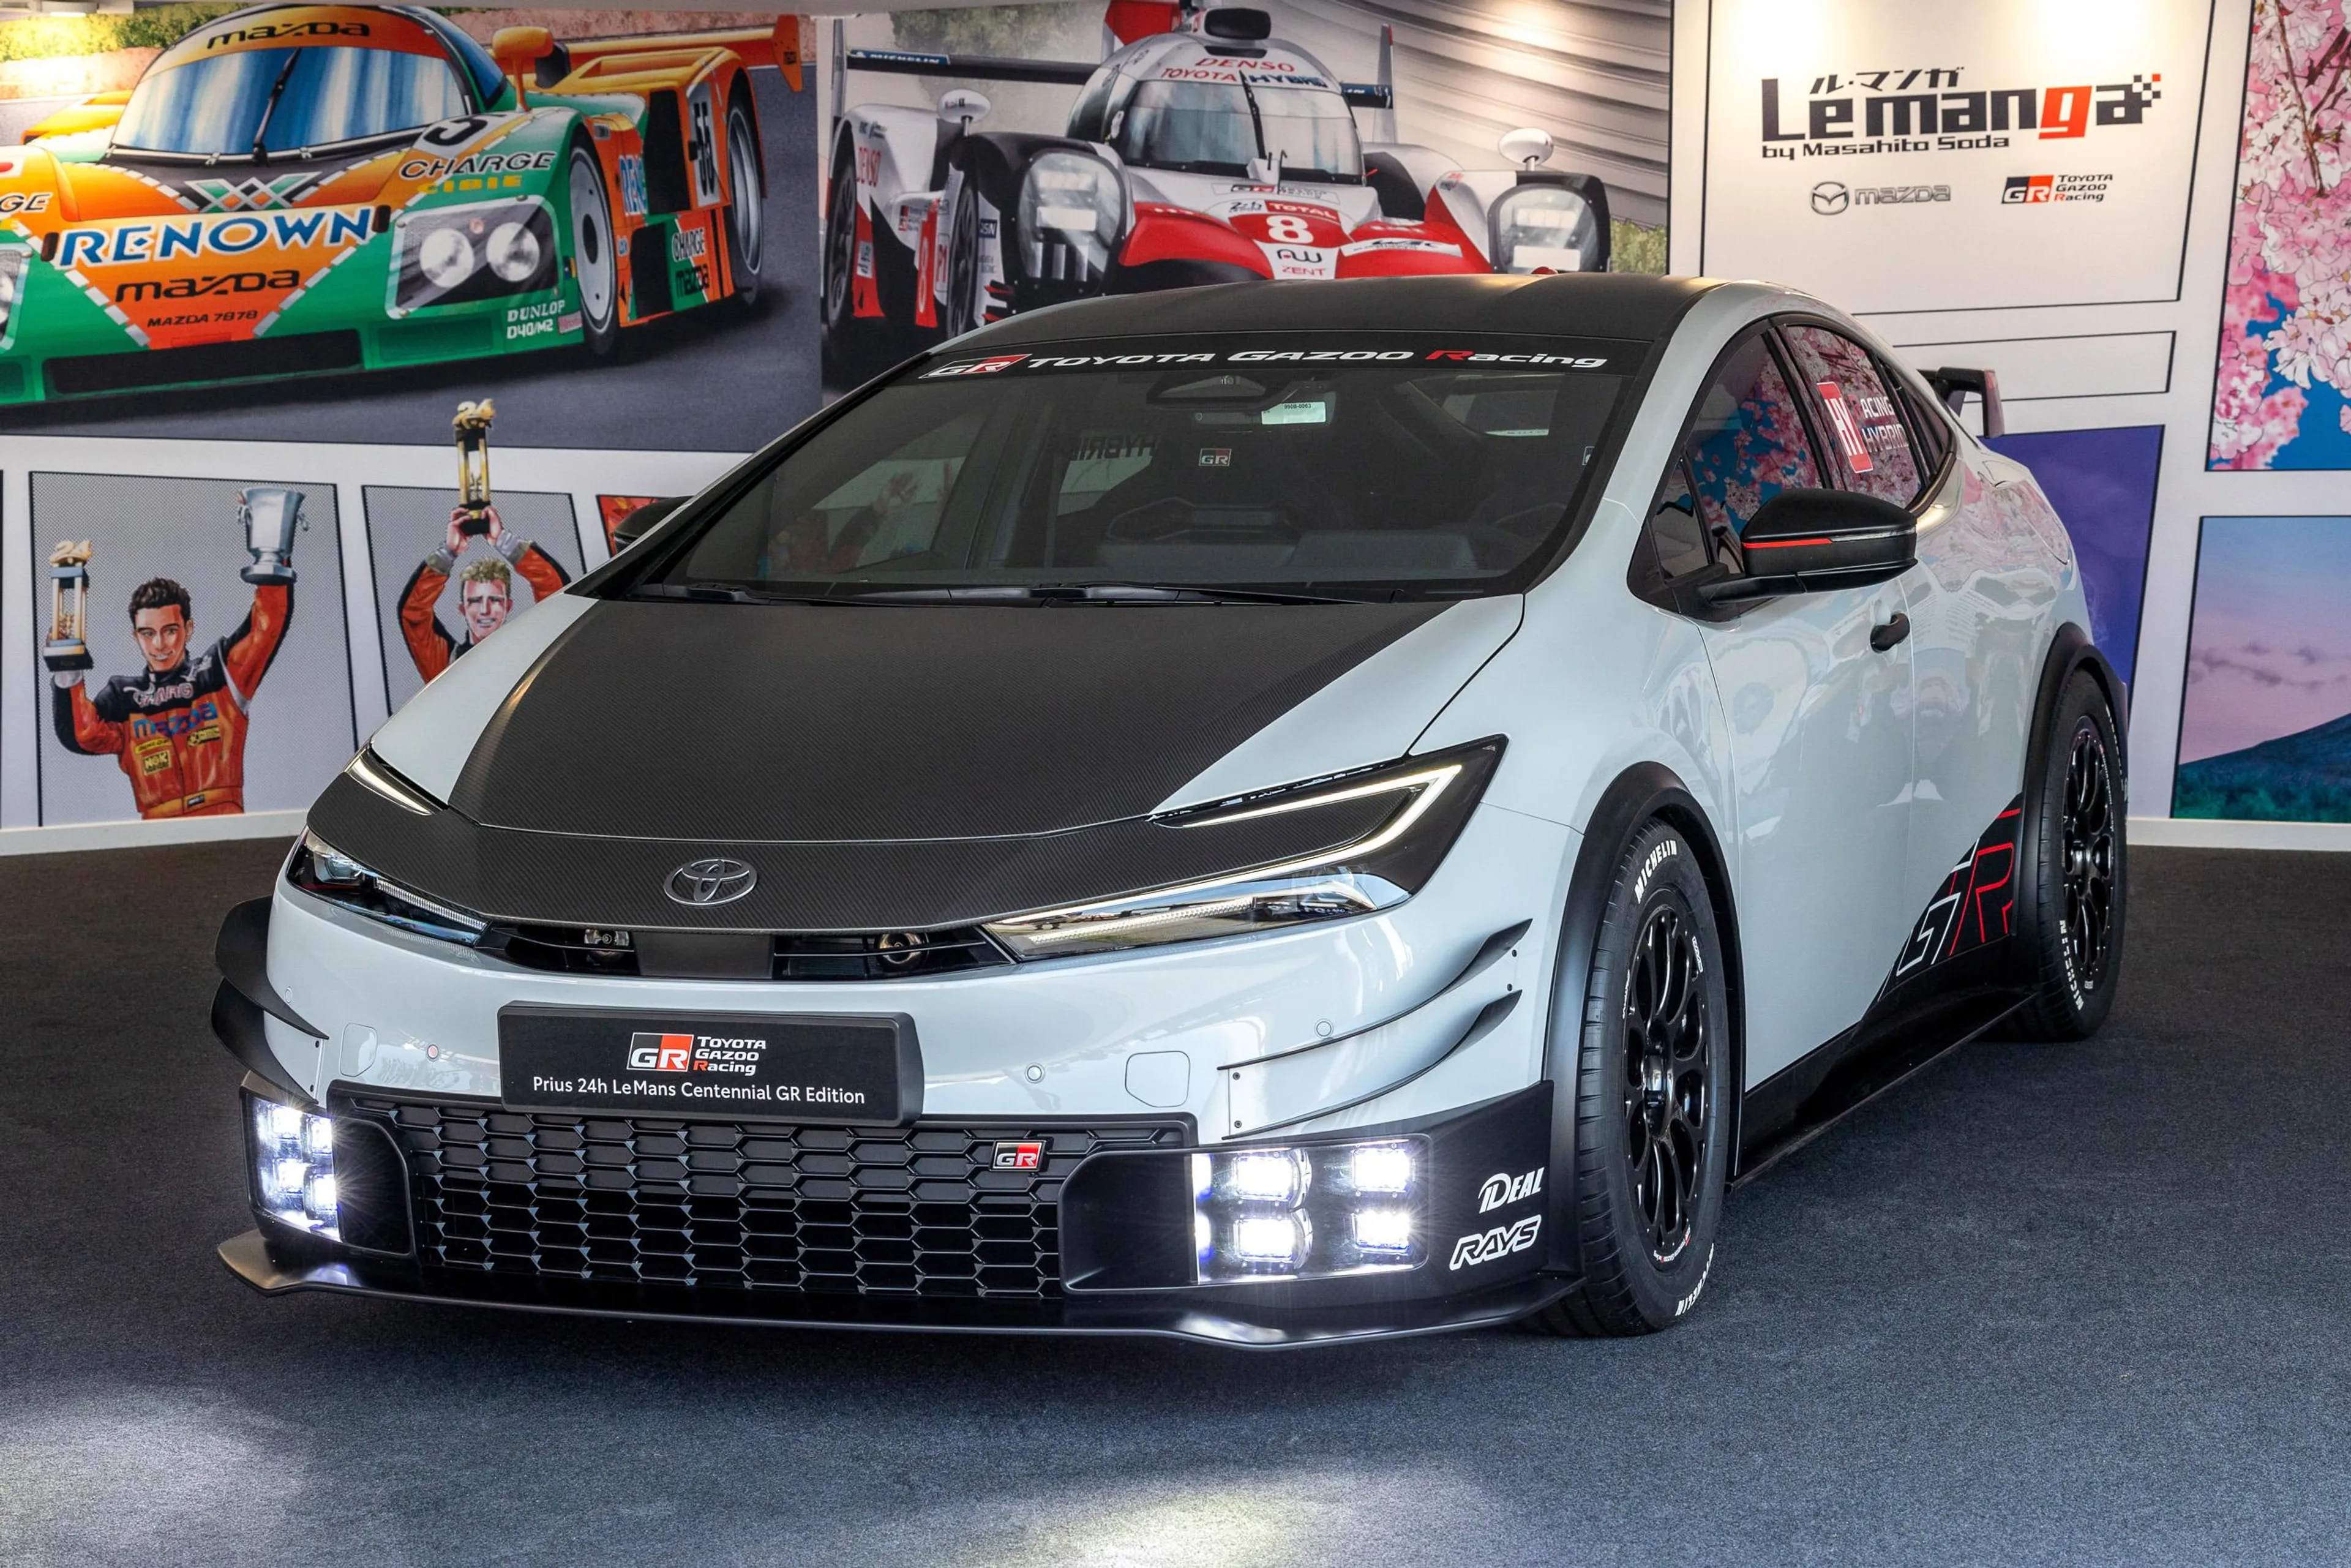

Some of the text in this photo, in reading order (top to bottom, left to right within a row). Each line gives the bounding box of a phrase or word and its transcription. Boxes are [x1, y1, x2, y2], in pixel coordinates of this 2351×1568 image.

[1195, 58, 1295, 72] DENSO
[1161, 68, 1237, 81] TOYOTA
[1762, 135, 2009, 160] by Masahito Soda
[402, 153, 556, 178] CHARGE
[2058, 174, 2113, 183] TOYOTA
[2004, 186, 2052, 204] GR
[2056, 184, 2107, 192] GAZOO
[2053, 192, 2104, 203] Racing
[1269, 202, 1337, 220] TOTAL
[60, 209, 373, 267] RENOWN
[1266, 215, 1314, 244] 8
[1282, 266, 1325, 276] ZENT
[507, 299, 566, 322] DUNLOP
[147, 313, 209, 328] MAZDA
[929, 350, 1608, 377] GR TOYOTA GAZOO Racing
[1201, 454, 1230, 466] GR
[1634, 840, 1677, 904] MICHELIN
[697, 1036, 767, 1049] TOYOTA
[631, 1048, 688, 1070] GR
[696, 1048, 759, 1062] GAZOO
[693, 1060, 757, 1076] Racing
[533, 1076, 573, 1092] Prius
[577, 1078, 607, 1094] 24h
[681, 1082, 771, 1100] Centennial
[776, 1087, 801, 1101] GR
[806, 1087, 864, 1105] Edition
[997, 1152, 1037, 1166] GR
[1449, 1214, 1542, 1271] RAYS
